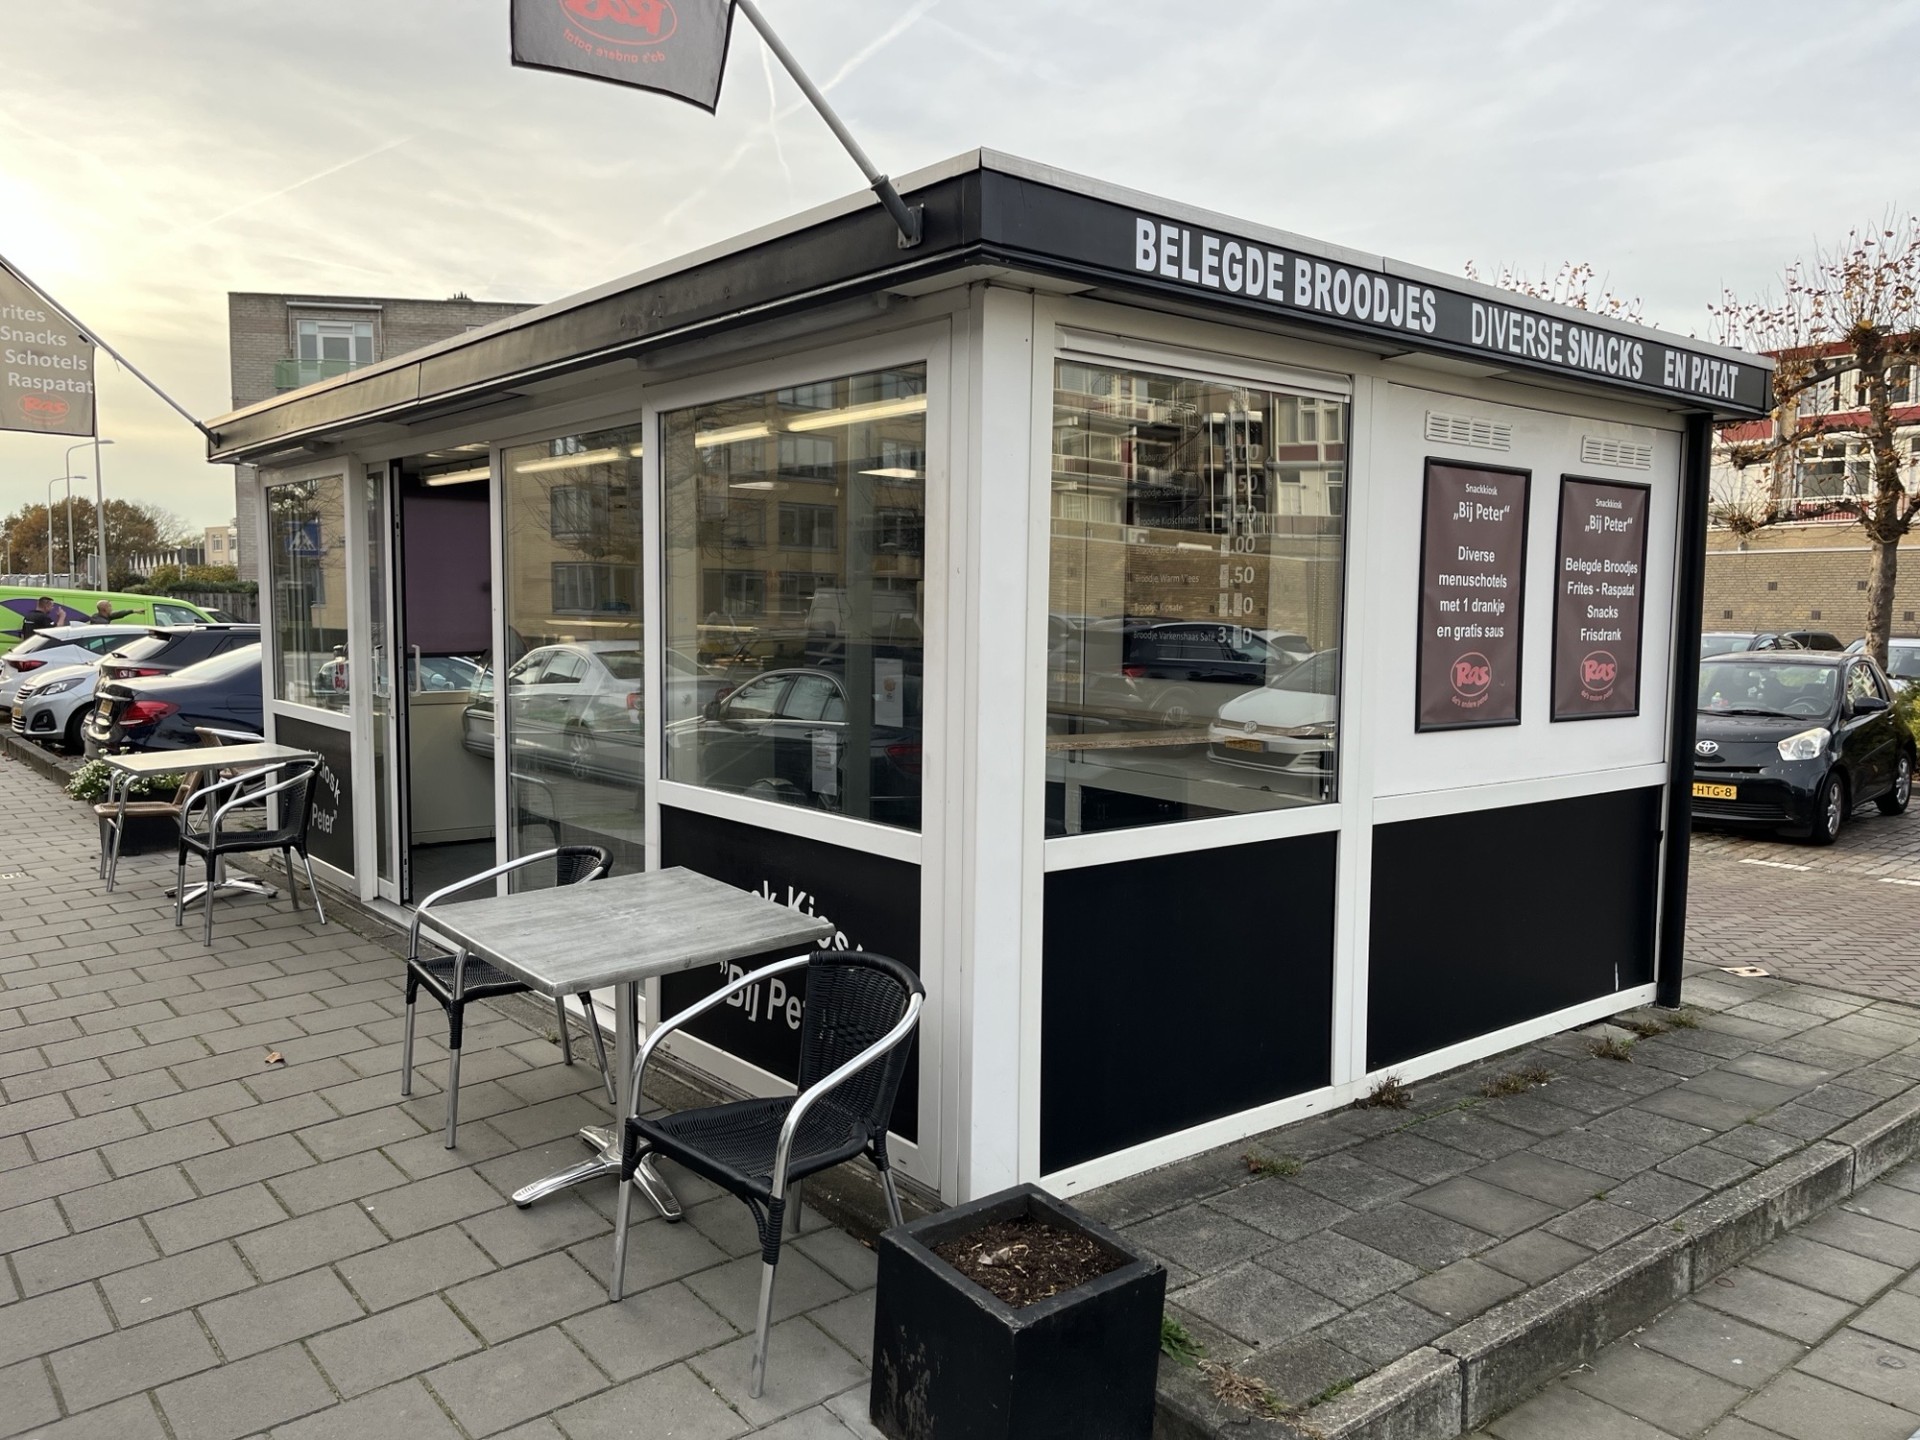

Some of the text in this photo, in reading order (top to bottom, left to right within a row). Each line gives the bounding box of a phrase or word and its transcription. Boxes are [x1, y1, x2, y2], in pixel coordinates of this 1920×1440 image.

[0, 304, 46, 323] rites
[1136, 217, 1738, 399] BELEGDE BROODJES DIVERSE SNACKS EN PATAT
[0, 326, 67, 346] Snacks
[5, 349, 88, 371] Schotels
[8, 372, 94, 393] Raspatat
[1465, 483, 1498, 496] Snackkiosk
[1458, 546, 1495, 562] Diverse
[1565, 557, 1638, 576] Belegde Broodjes
[1438, 573, 1507, 588] menuschotels
[1567, 581, 1594, 595] Frites
[1601, 583, 1635, 598] Raspatat
[1440, 598, 1505, 616] met 1 drankje
[1587, 605, 1619, 619] Snacks
[1436, 624, 1504, 641] en gratis saus
[1580, 627, 1621, 642] Frisdrank
[317, 752, 340, 806] iosk
